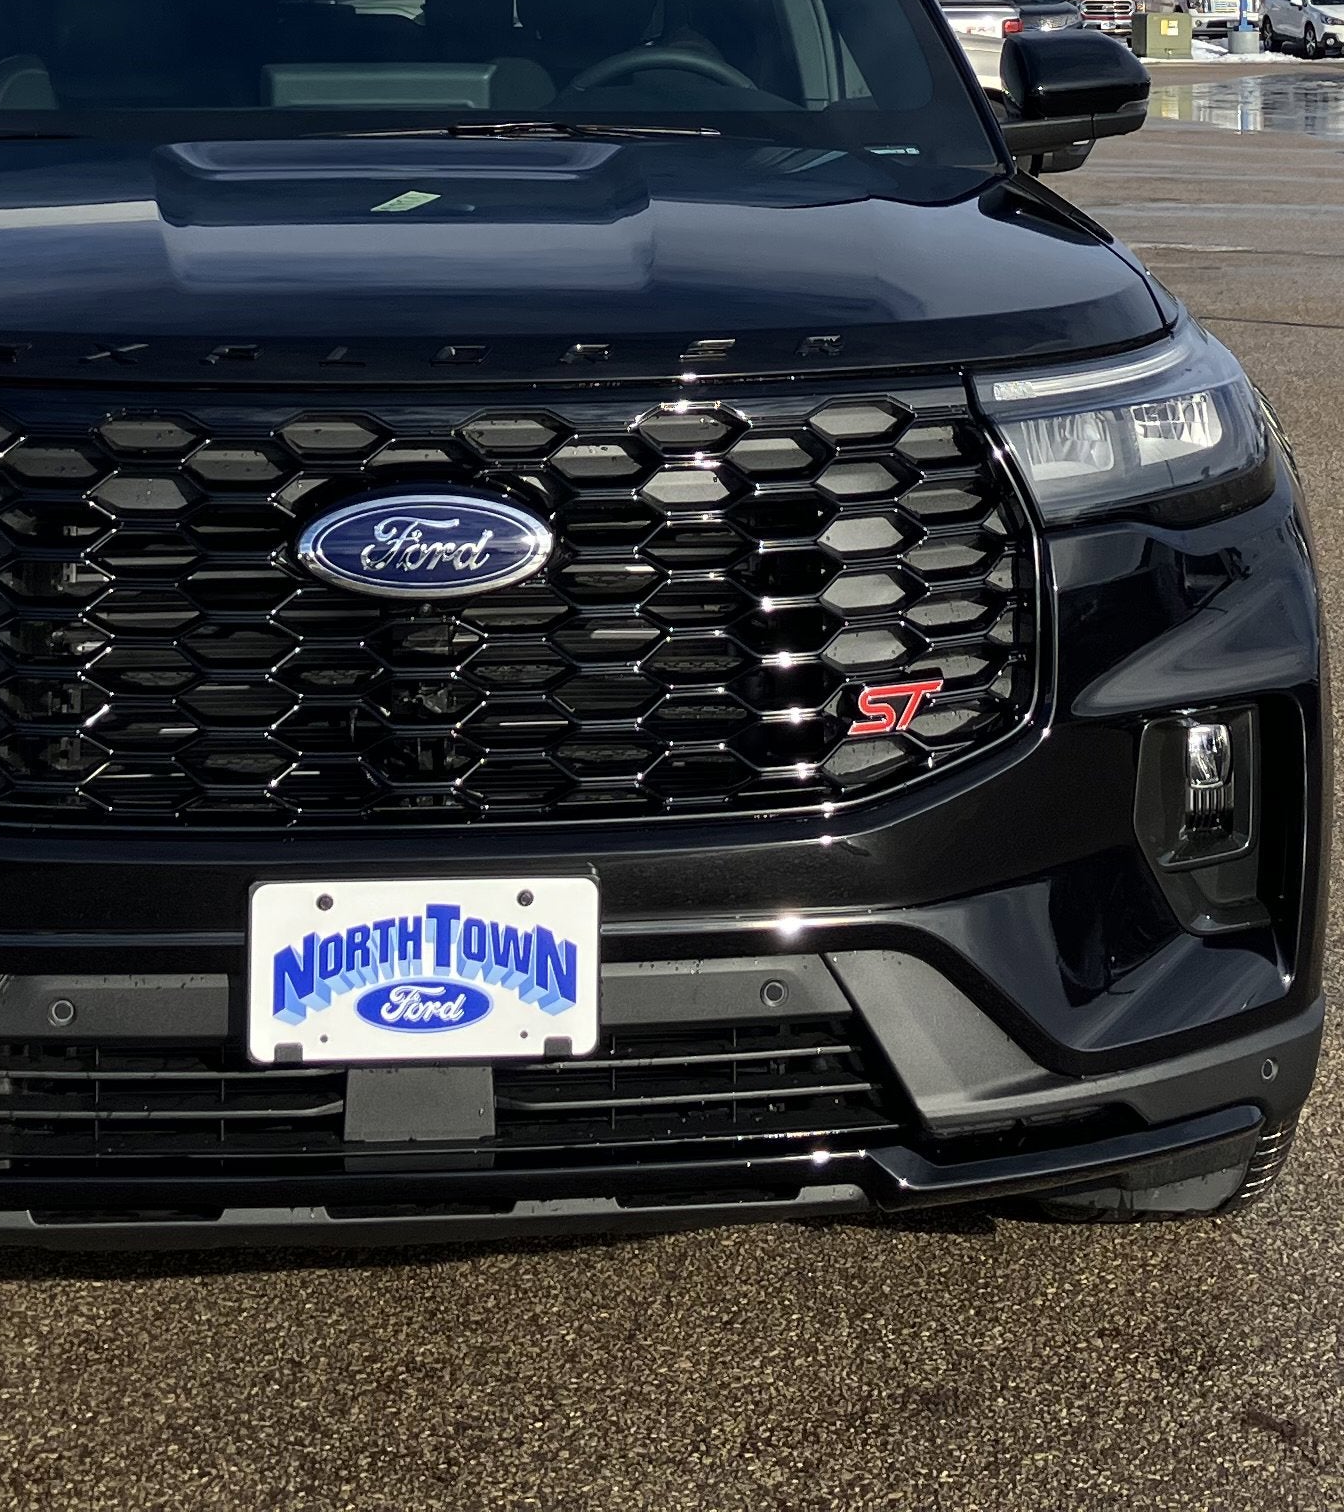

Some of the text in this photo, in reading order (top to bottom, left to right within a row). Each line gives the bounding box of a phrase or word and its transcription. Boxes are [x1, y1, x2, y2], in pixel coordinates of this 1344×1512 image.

[360, 515, 493, 573] Ford
[847, 678, 944, 735] ST
[380, 984, 467, 1024] Ford
